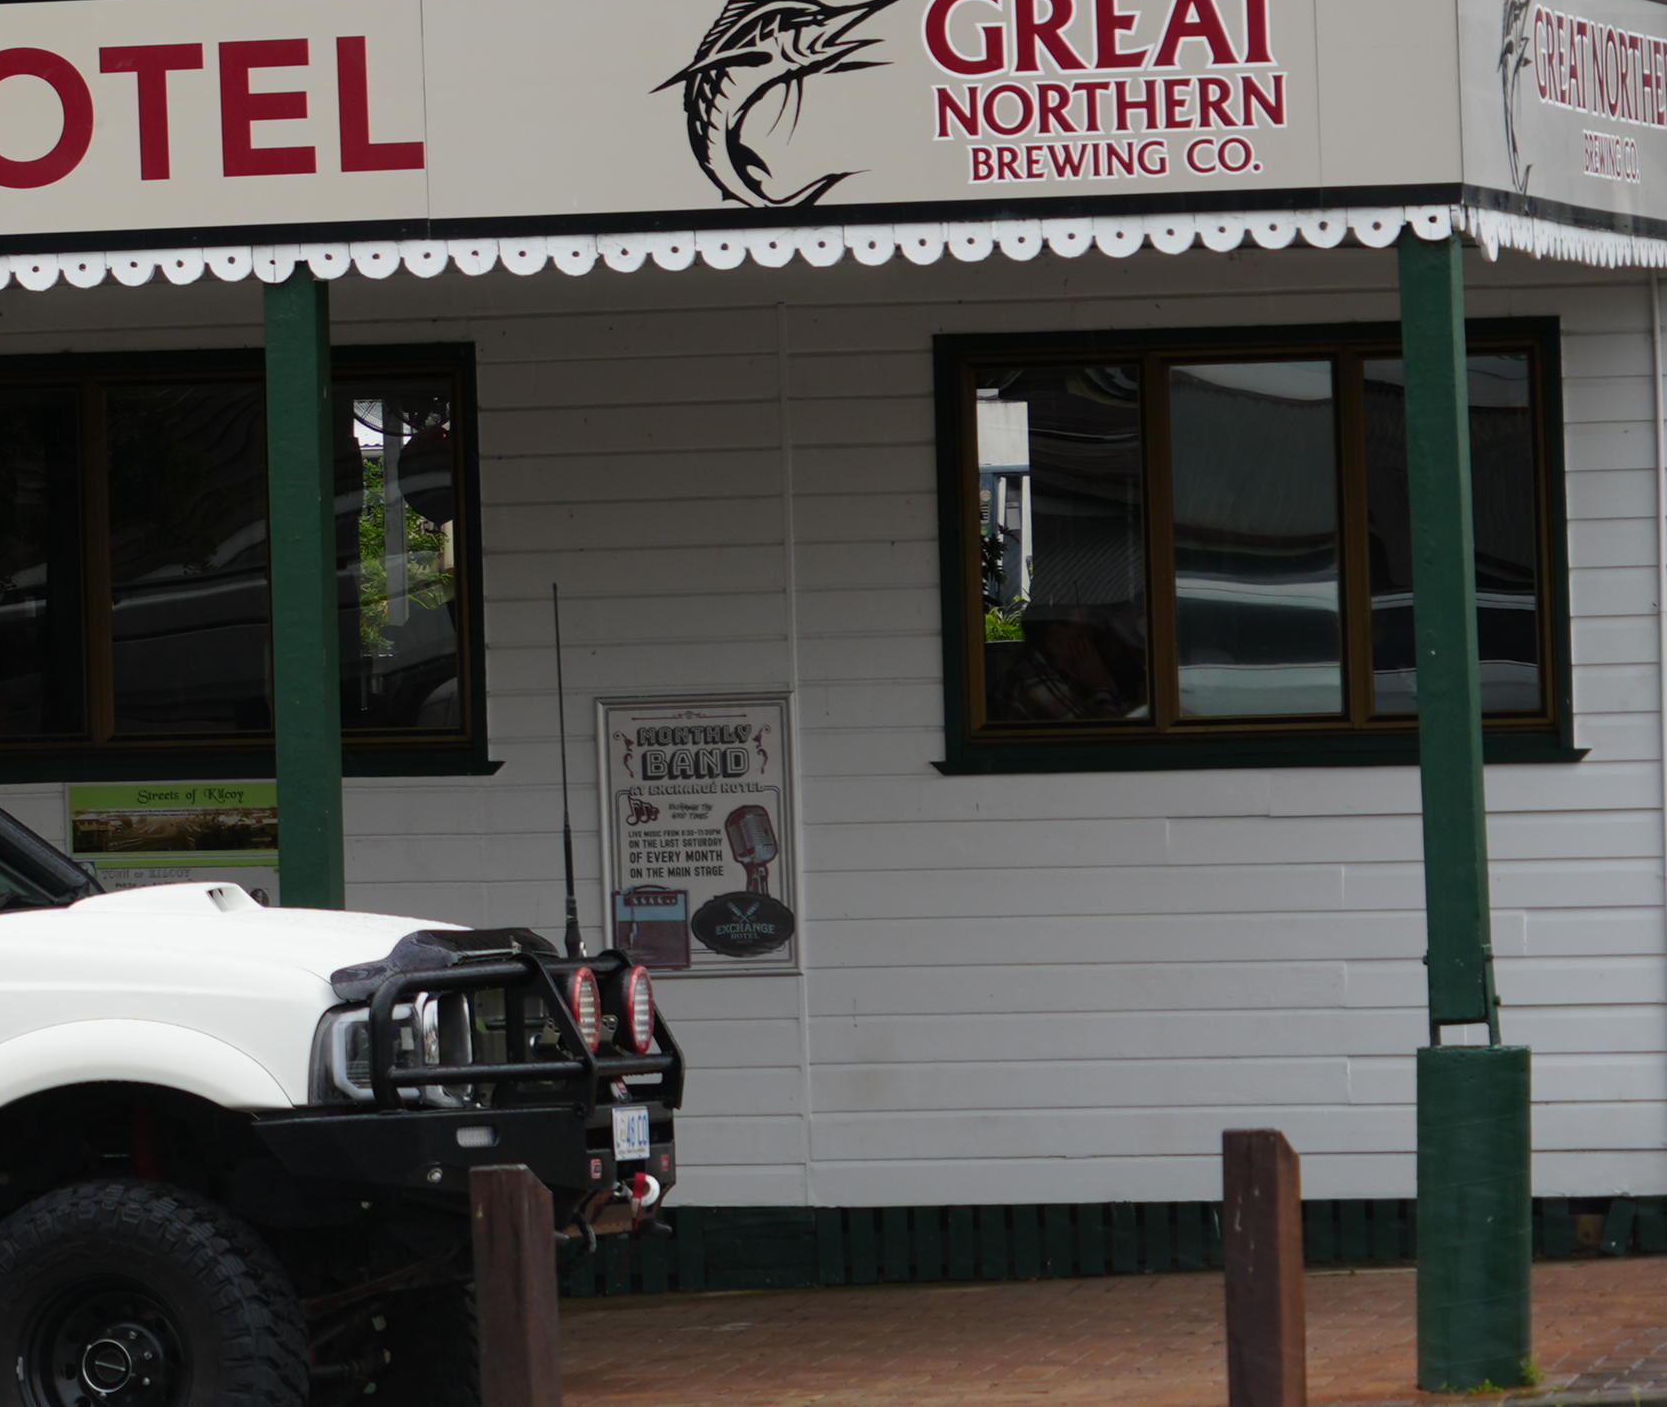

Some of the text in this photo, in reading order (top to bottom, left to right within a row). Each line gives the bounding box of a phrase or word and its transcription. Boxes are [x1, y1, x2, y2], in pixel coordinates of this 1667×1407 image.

[1533, 3, 1667, 129] GREAT NORTHE
[933, 72, 1287, 140] NORTHERN
[969, 136, 1262, 184] BREWING CO.
[1583, 130, 1621, 181] BREWING
[637, 724, 753, 747] MONTHLY
[642, 747, 750, 780] BAND
[137, 788, 245, 805] Streets of Kilcoy
[649, 784, 717, 796] EXCHANGE
[721, 782, 764, 794] HOTEL
[628, 830, 642, 838] LIVE
[663, 829, 679, 837] FROM
[629, 837, 723, 848] ON THE LAST SATURDAY
[629, 849, 723, 863] OF EVERY MONTH
[630, 865, 724, 878] ON THE MAIN STAGE
[715, 922, 776, 936] EXCHANGE
